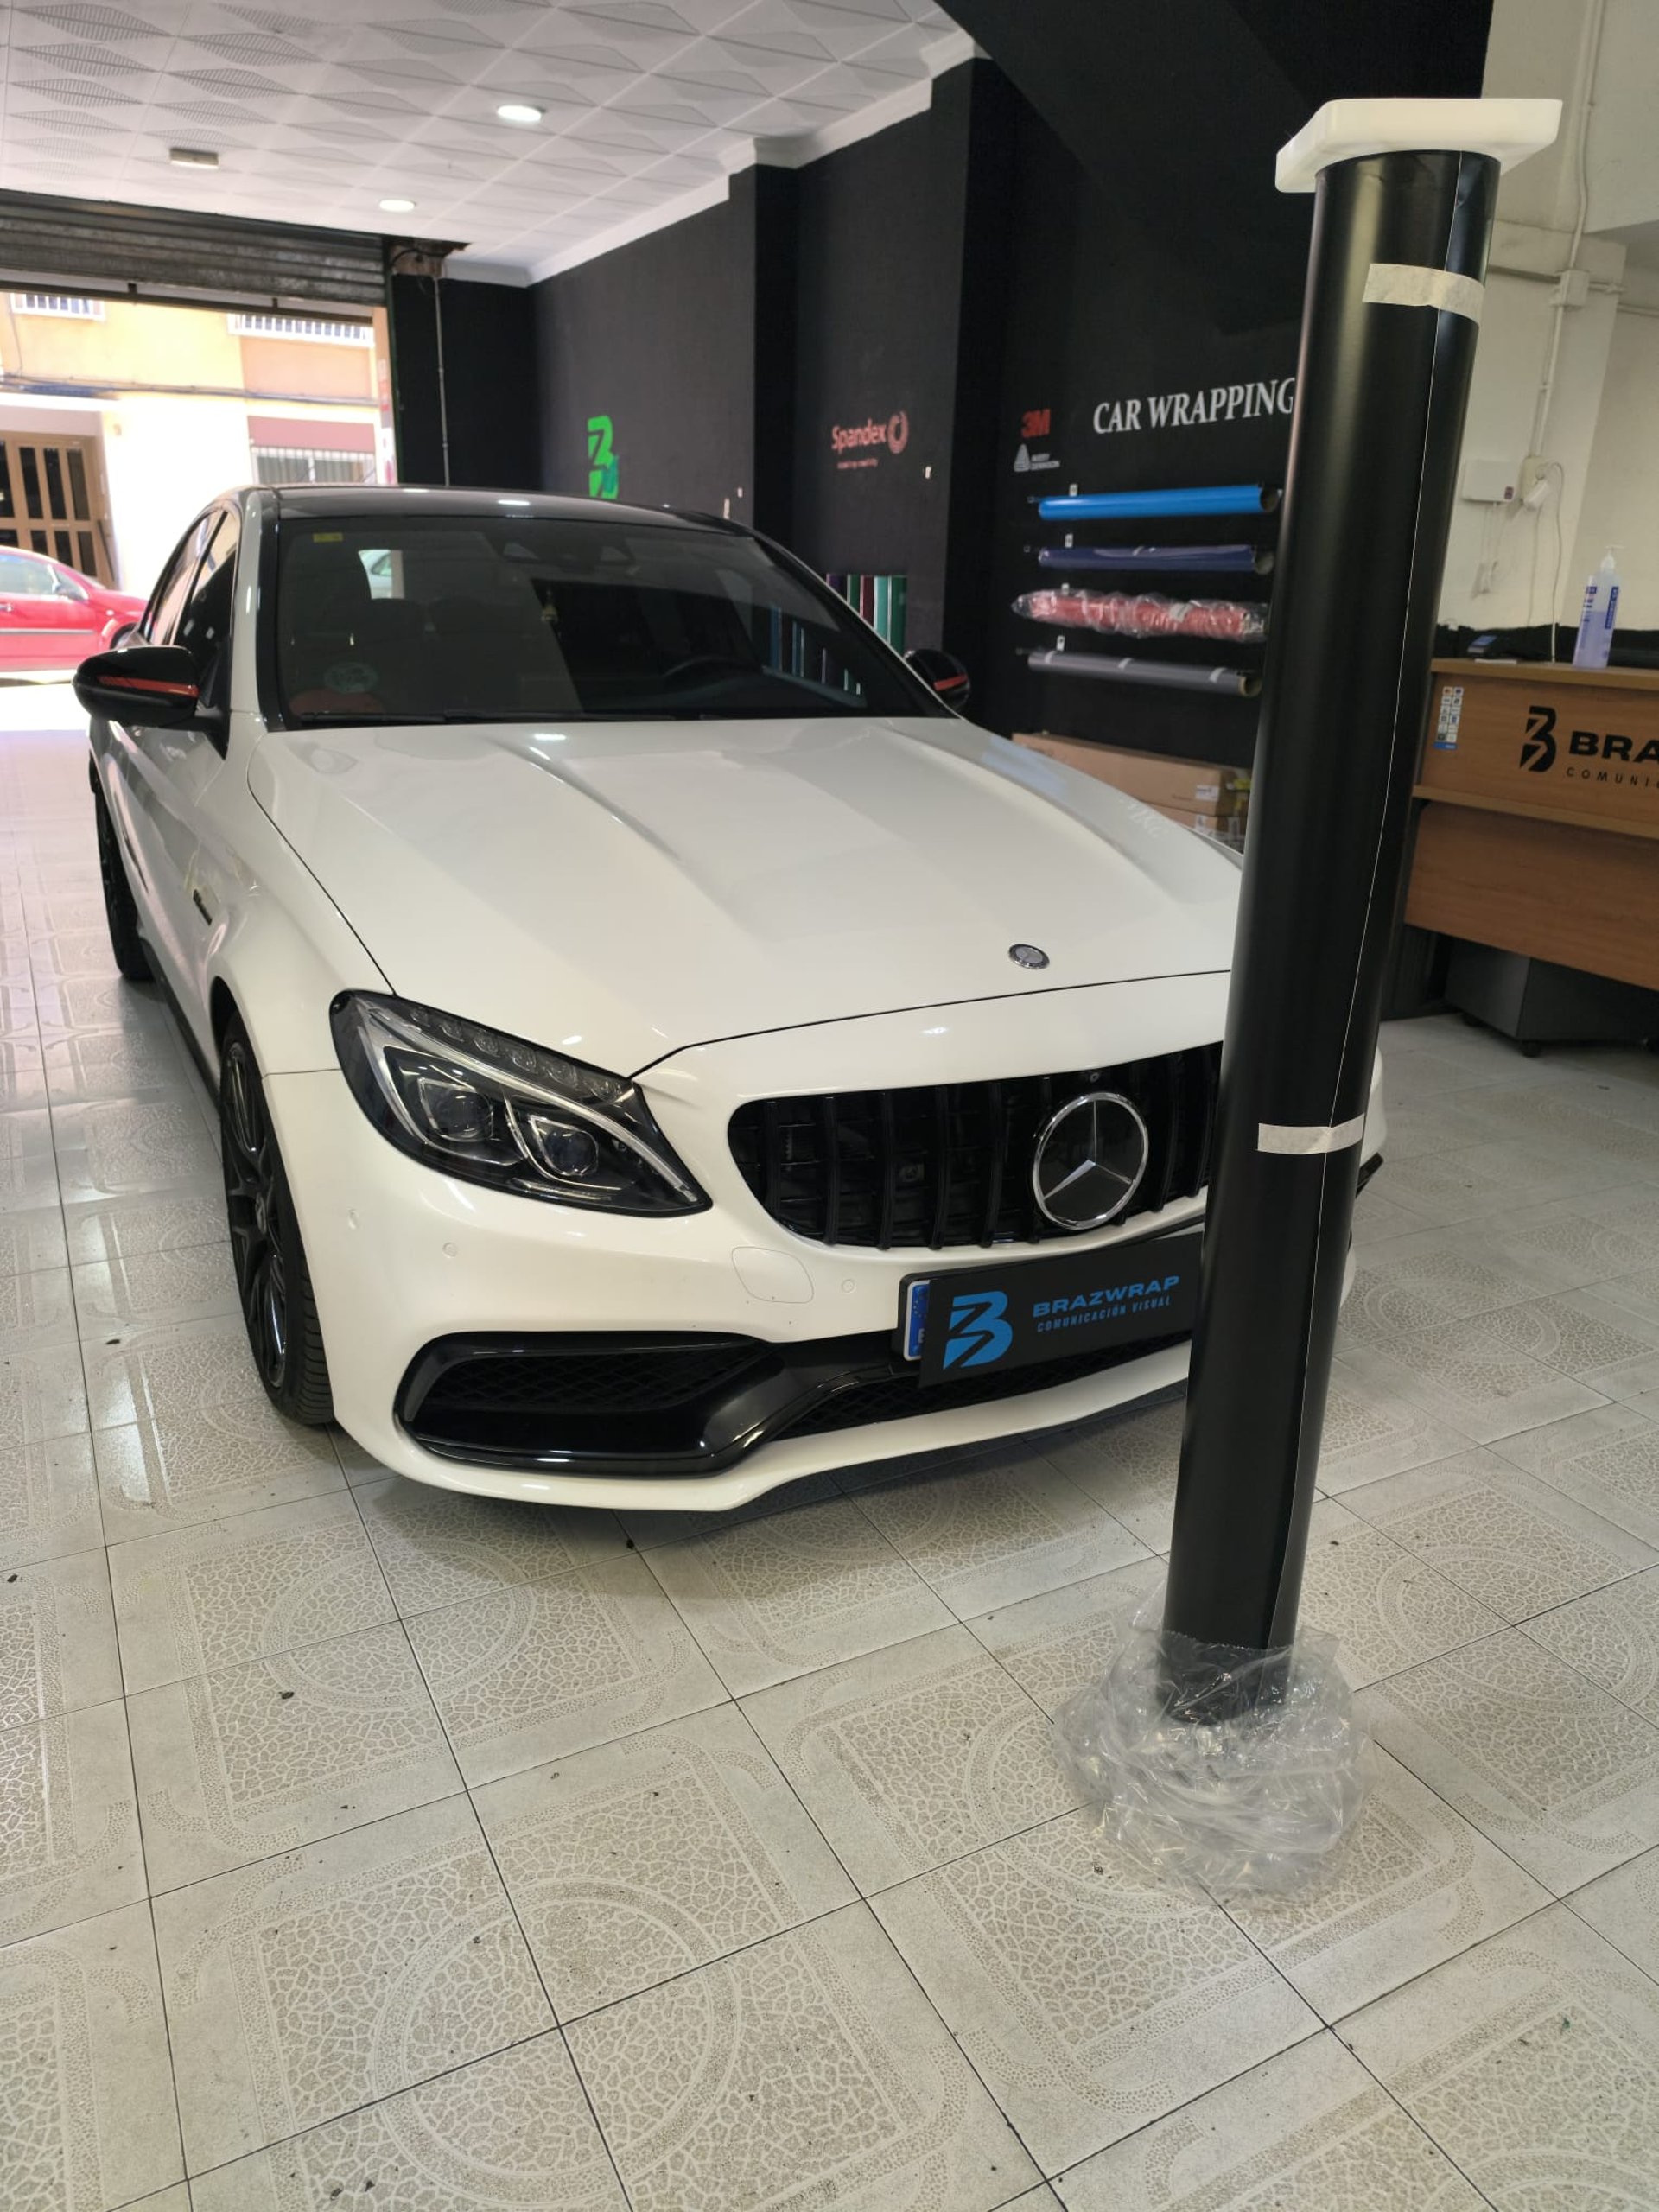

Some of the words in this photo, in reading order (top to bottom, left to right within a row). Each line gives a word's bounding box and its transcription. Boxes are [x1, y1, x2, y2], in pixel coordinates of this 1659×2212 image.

[1021, 408, 1051, 438] 3M
[1093, 399, 1142, 434] CAR
[1147, 378, 1295, 429] WRAPPING
[831, 418, 887, 454] Spandex
[1033, 1275, 1180, 1318] BRAZWRAP
[1132, 1294, 1171, 1313] VISUAL
